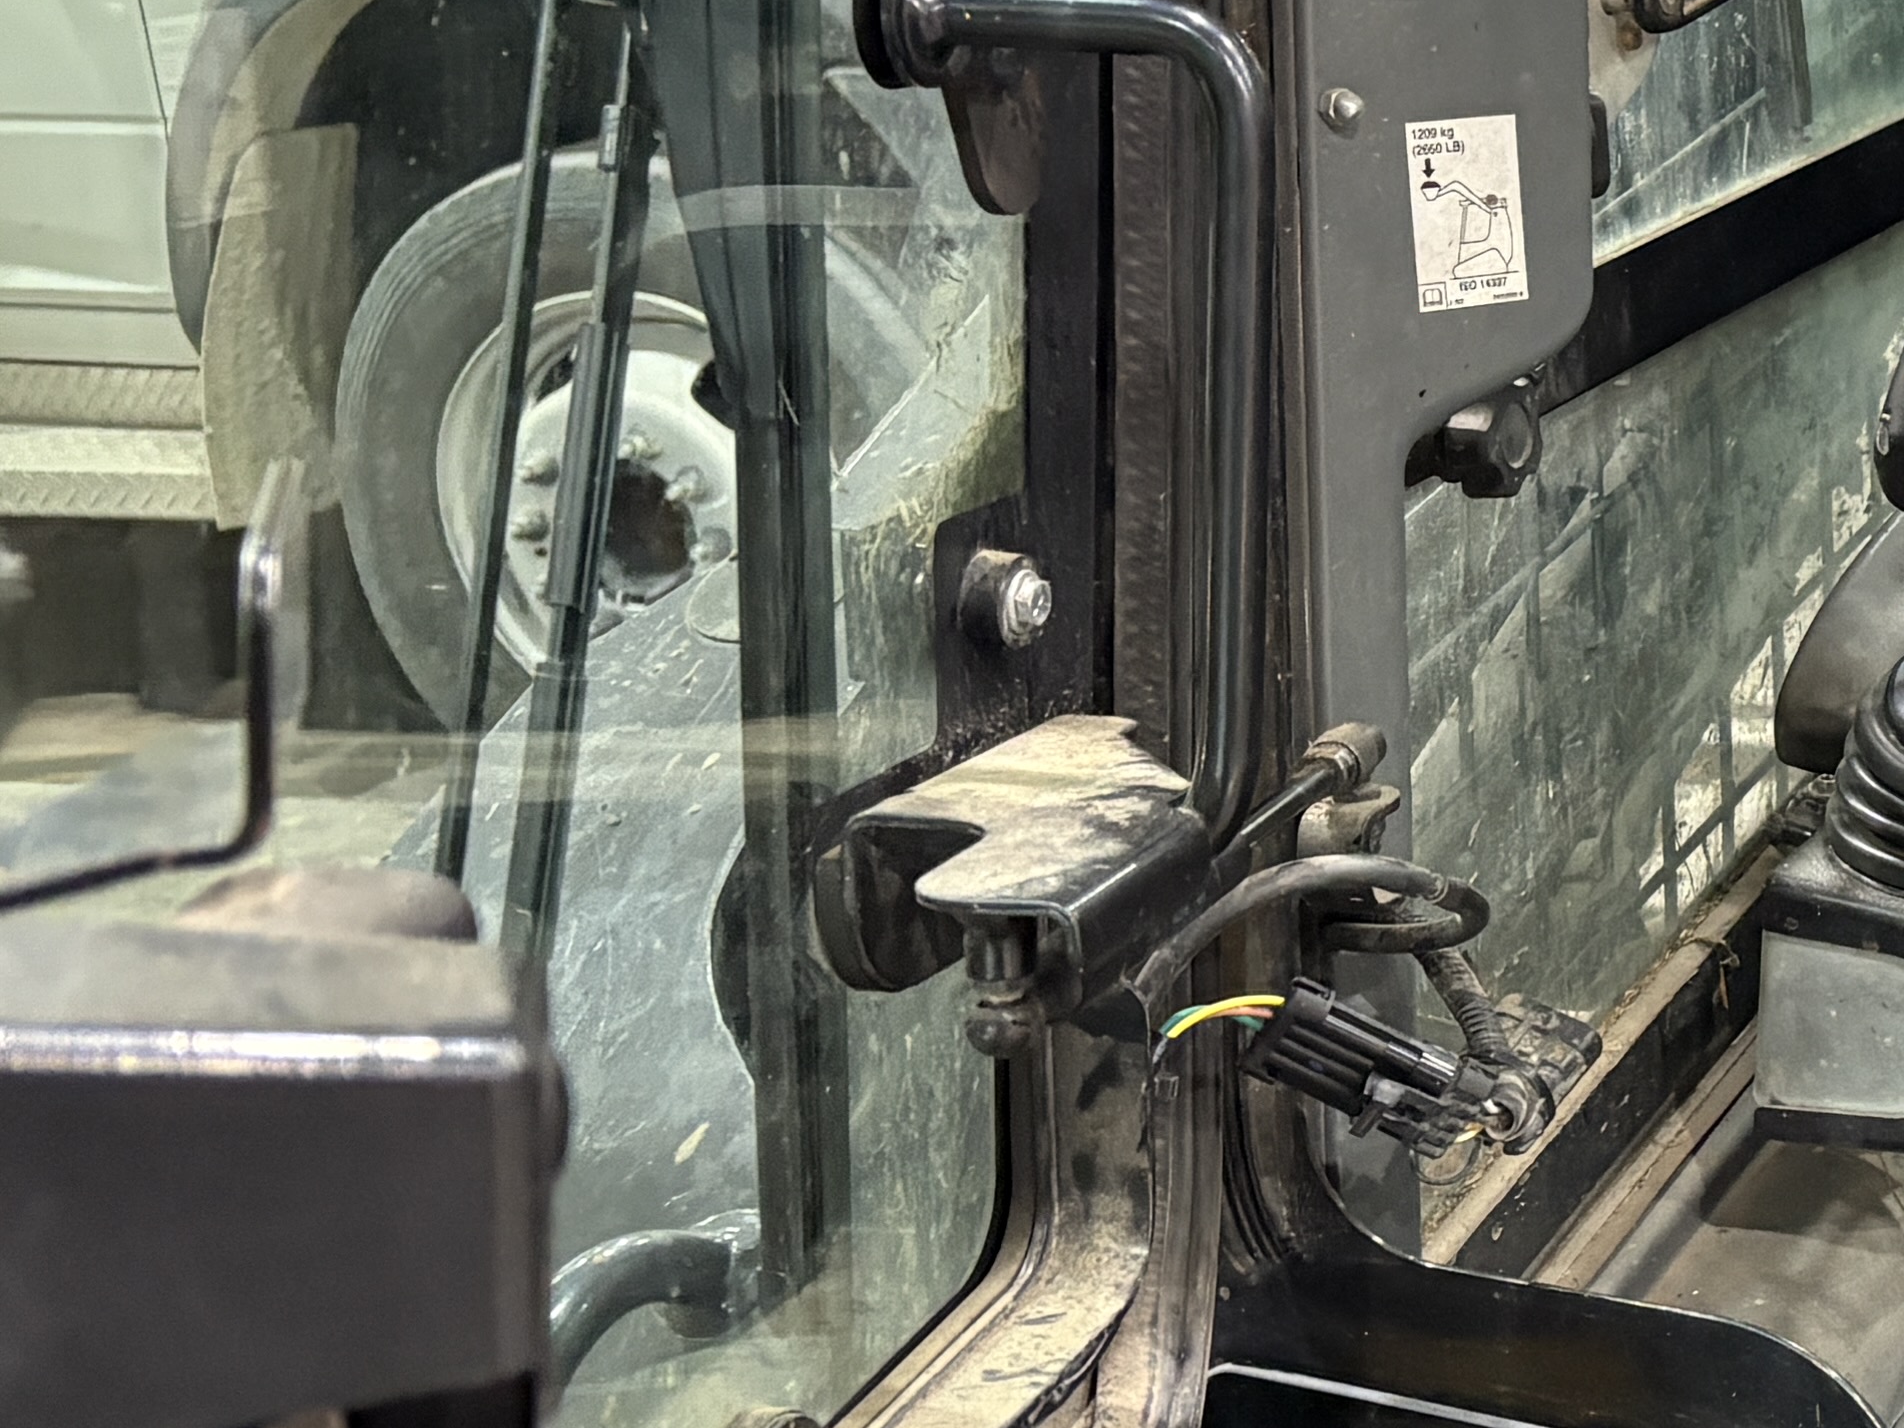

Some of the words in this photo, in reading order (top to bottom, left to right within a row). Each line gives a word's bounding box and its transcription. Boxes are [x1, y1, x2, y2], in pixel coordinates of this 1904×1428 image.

[1412, 127, 1438, 141] 1209
[1440, 126, 1455, 140] kg
[1445, 140, 1465, 156] LB)
